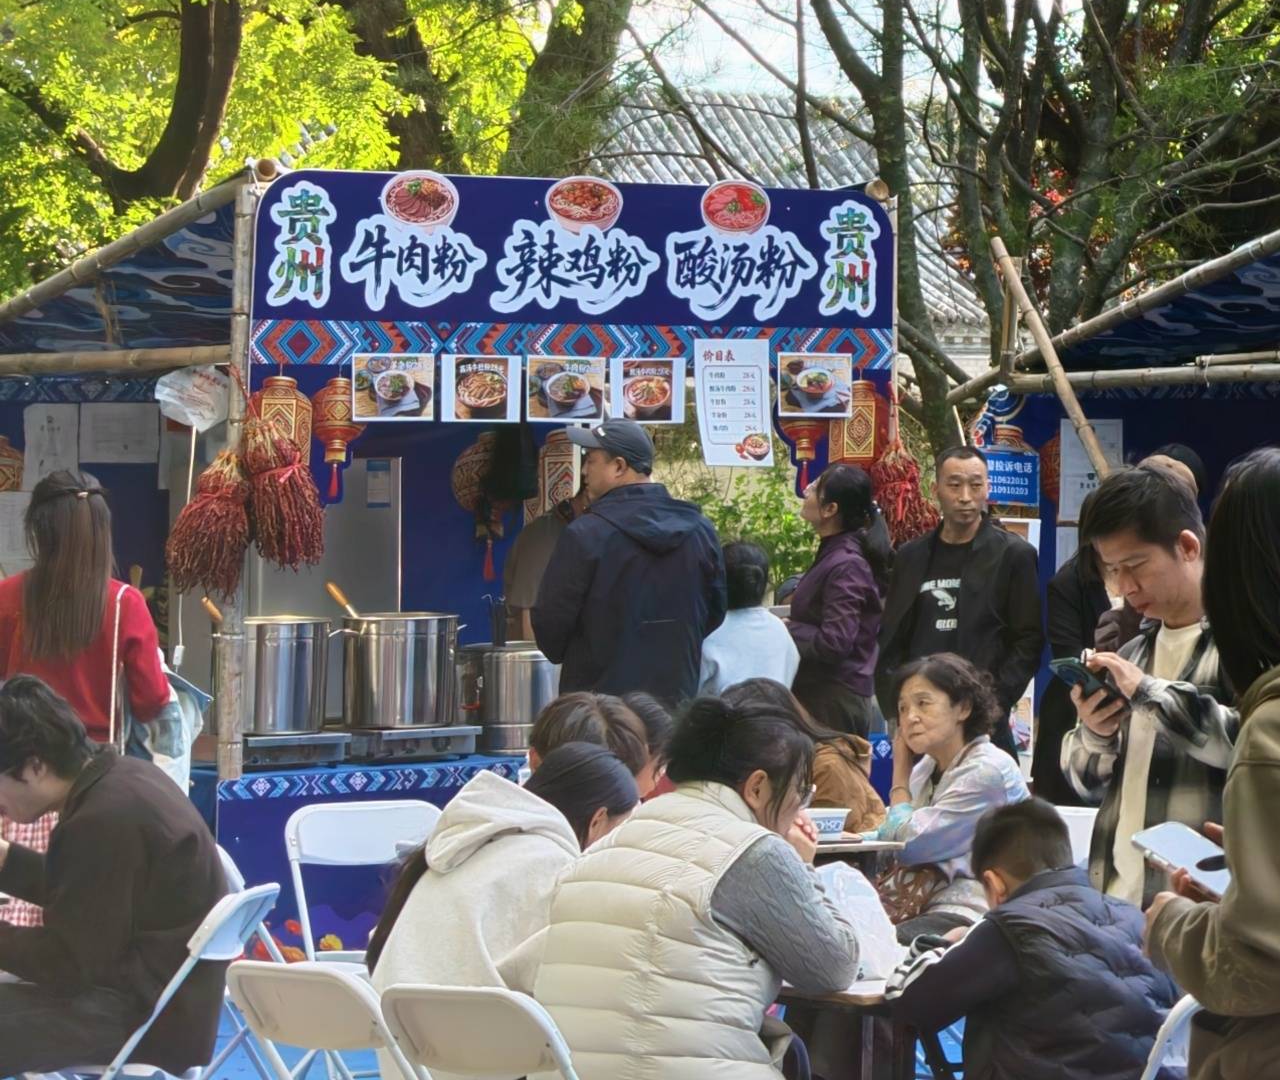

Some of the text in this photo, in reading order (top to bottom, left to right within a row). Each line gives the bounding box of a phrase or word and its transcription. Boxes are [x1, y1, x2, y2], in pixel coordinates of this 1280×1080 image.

[274, 187, 330, 301] 贵州
[349, 223, 479, 300] 牛肉粉
[498, 228, 653, 306] 辣鸡粉
[672, 233, 811, 312] 酸汤粉
[825, 206, 874, 311] 贵州
[703, 349, 736, 363] 价目表
